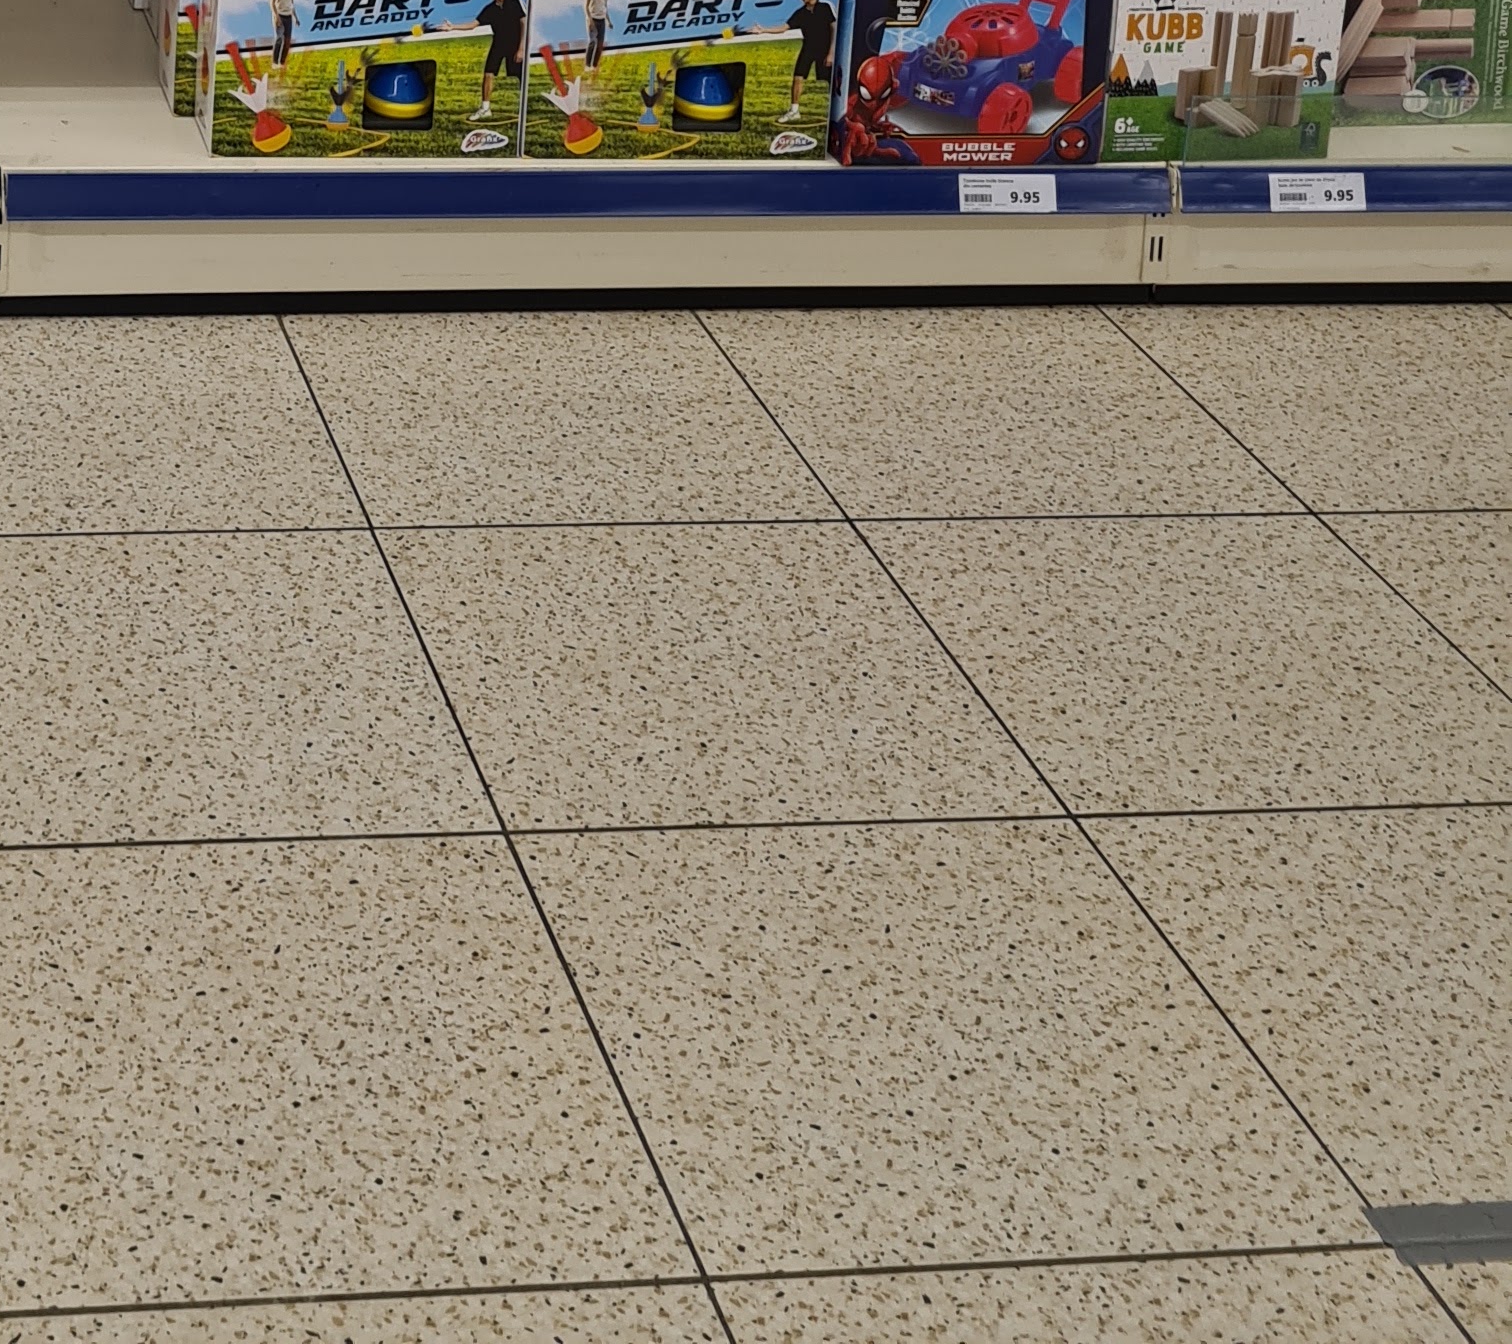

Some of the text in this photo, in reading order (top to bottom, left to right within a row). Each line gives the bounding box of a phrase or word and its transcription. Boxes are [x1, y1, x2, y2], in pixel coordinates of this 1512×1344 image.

[310, 8, 435, 32] AND CADDY
[623, 11, 746, 35] AND CADDY
[1125, 12, 1204, 41] KUBB
[1143, 41, 1185, 54] GAME
[1493, 39, 1510, 110] Birchwood
[941, 142, 1016, 152] BUBBLE
[942, 152, 1012, 162] MOWER
[1010, 191, 1040, 203] 9.95
[1323, 189, 1354, 201] 9.95
